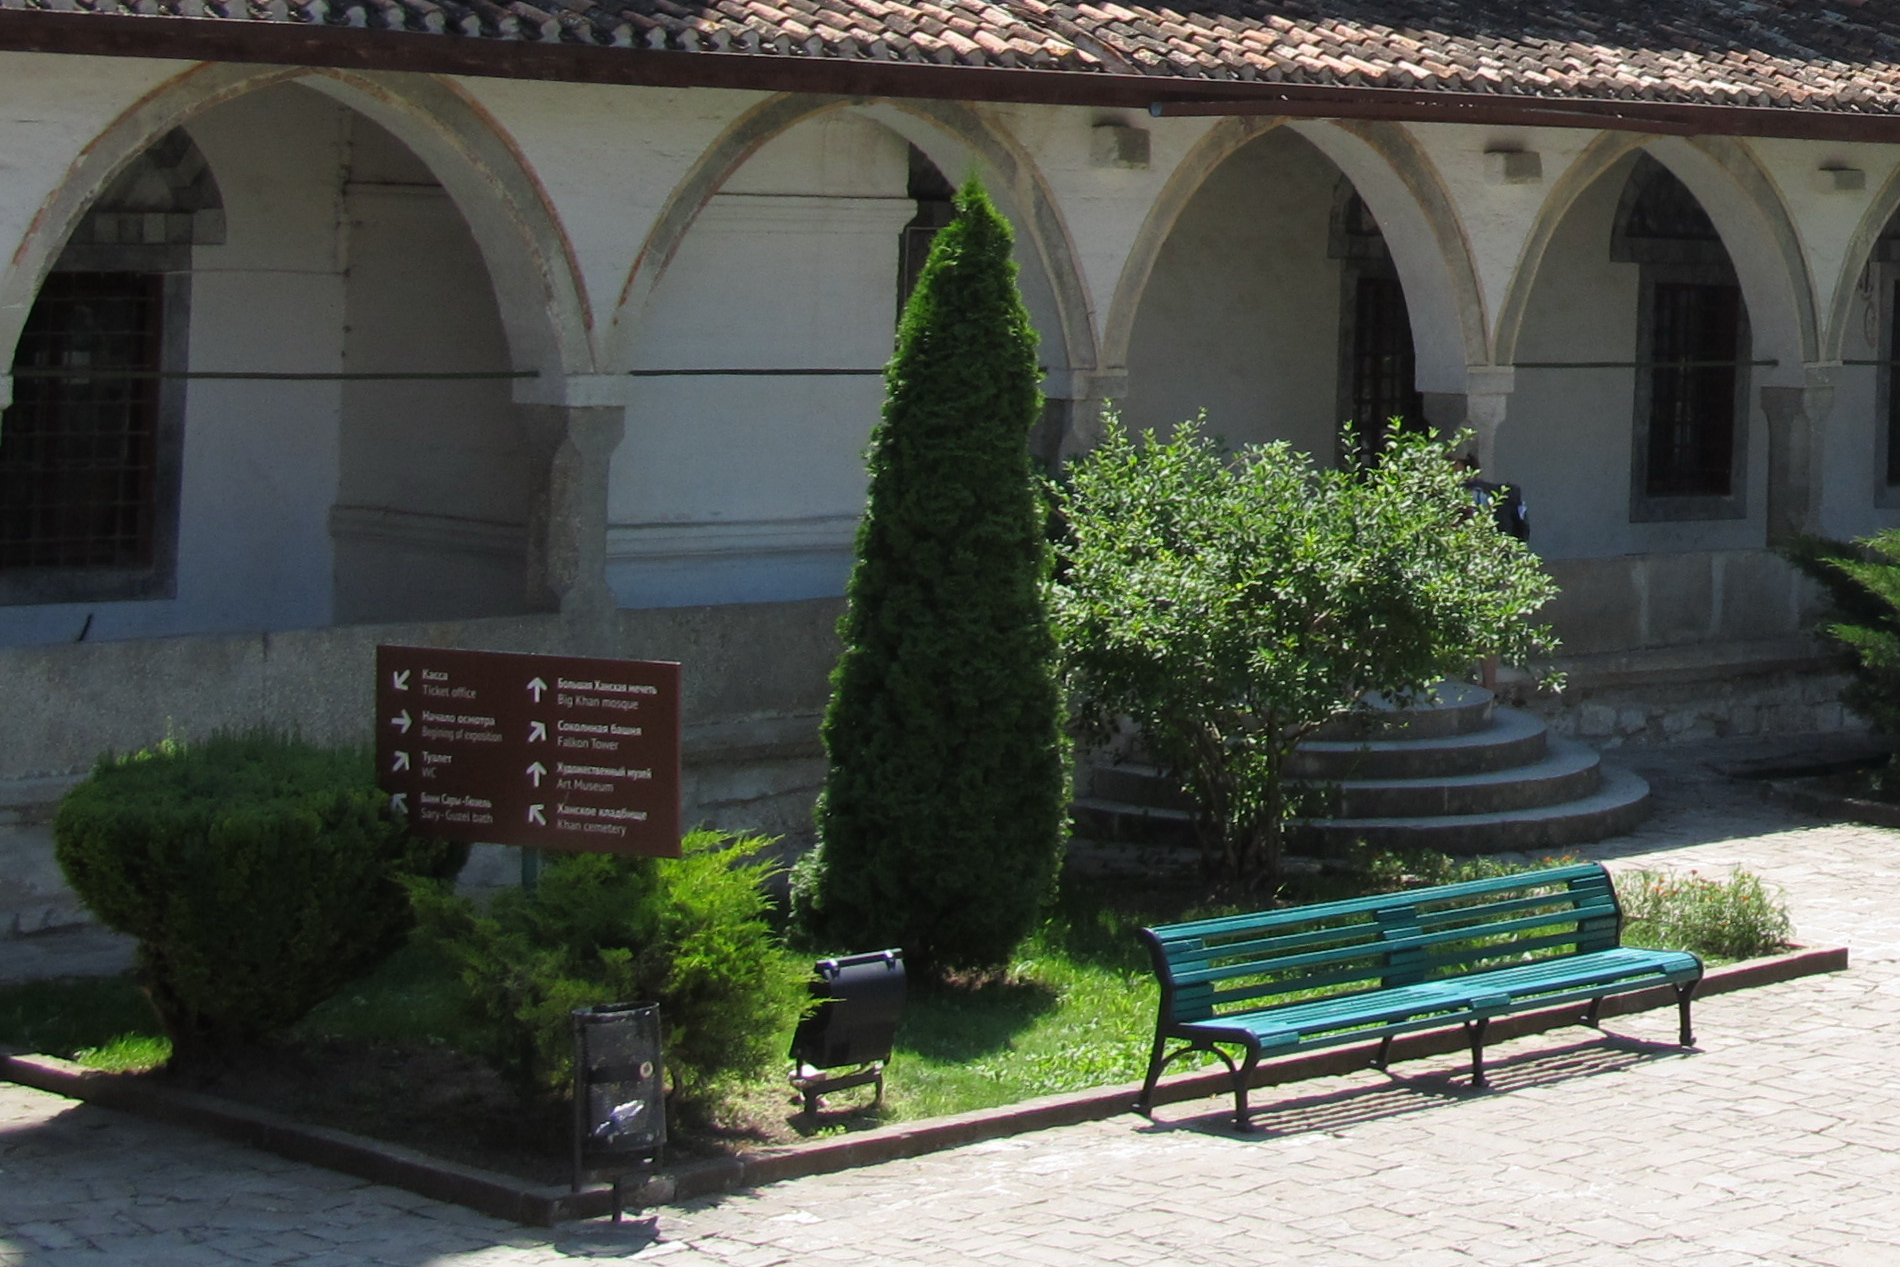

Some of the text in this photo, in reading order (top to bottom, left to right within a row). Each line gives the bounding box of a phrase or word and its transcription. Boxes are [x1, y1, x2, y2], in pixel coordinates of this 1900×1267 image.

[422, 669, 449, 681] Касса
[422, 684, 477, 699] Ticket office
[557, 677, 594, 690] Большая
[593, 680, 627, 693] Ханская
[557, 694, 639, 711] Big Khan mosque
[422, 710, 496, 728] Начало осмотра
[455, 728, 464, 739] of
[557, 719, 642, 736] Соколиная башня
[590, 738, 619, 751] Tower
[422, 767, 437, 778] WC
[627, 767, 653, 781] музей
[556, 779, 614, 792] Art Museum
[557, 803, 648, 822] Ханское кладбище
[557, 819, 627, 838] Khan cemetery
